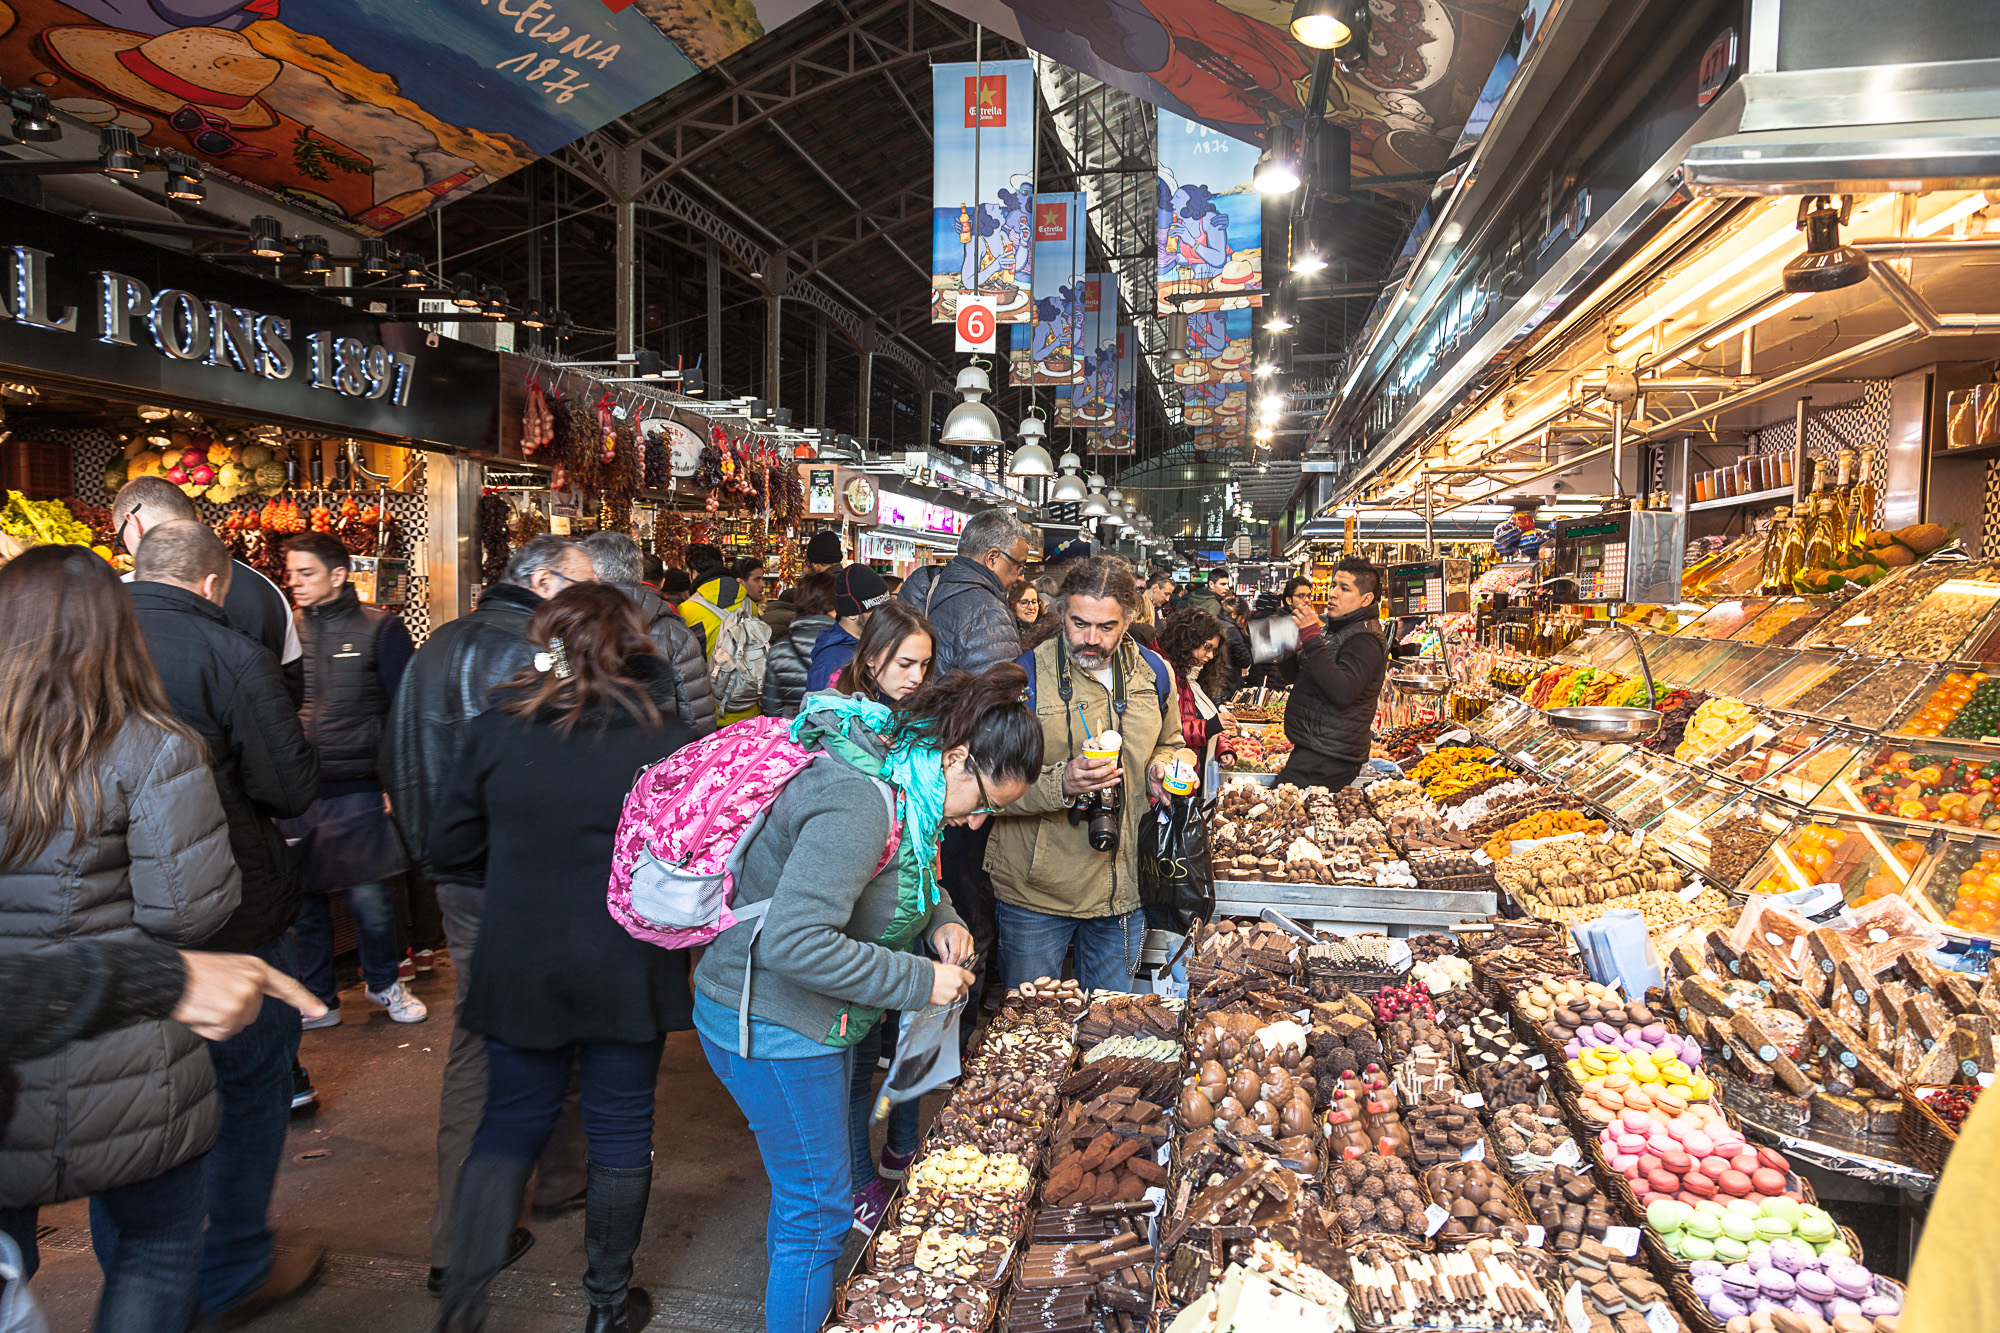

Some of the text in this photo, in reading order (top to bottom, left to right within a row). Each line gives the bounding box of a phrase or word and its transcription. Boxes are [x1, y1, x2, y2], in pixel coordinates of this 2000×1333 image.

[481, 0, 621, 69] CELONA
[496, 52, 590, 104] 1876
[968, 106, 1002, 116] Etrella
[1193, 140, 1229, 156] 1876
[1038, 225, 1064, 233] Estrella
[0, 245, 416, 407] L PONS 1897
[967, 310, 985, 338] 6
